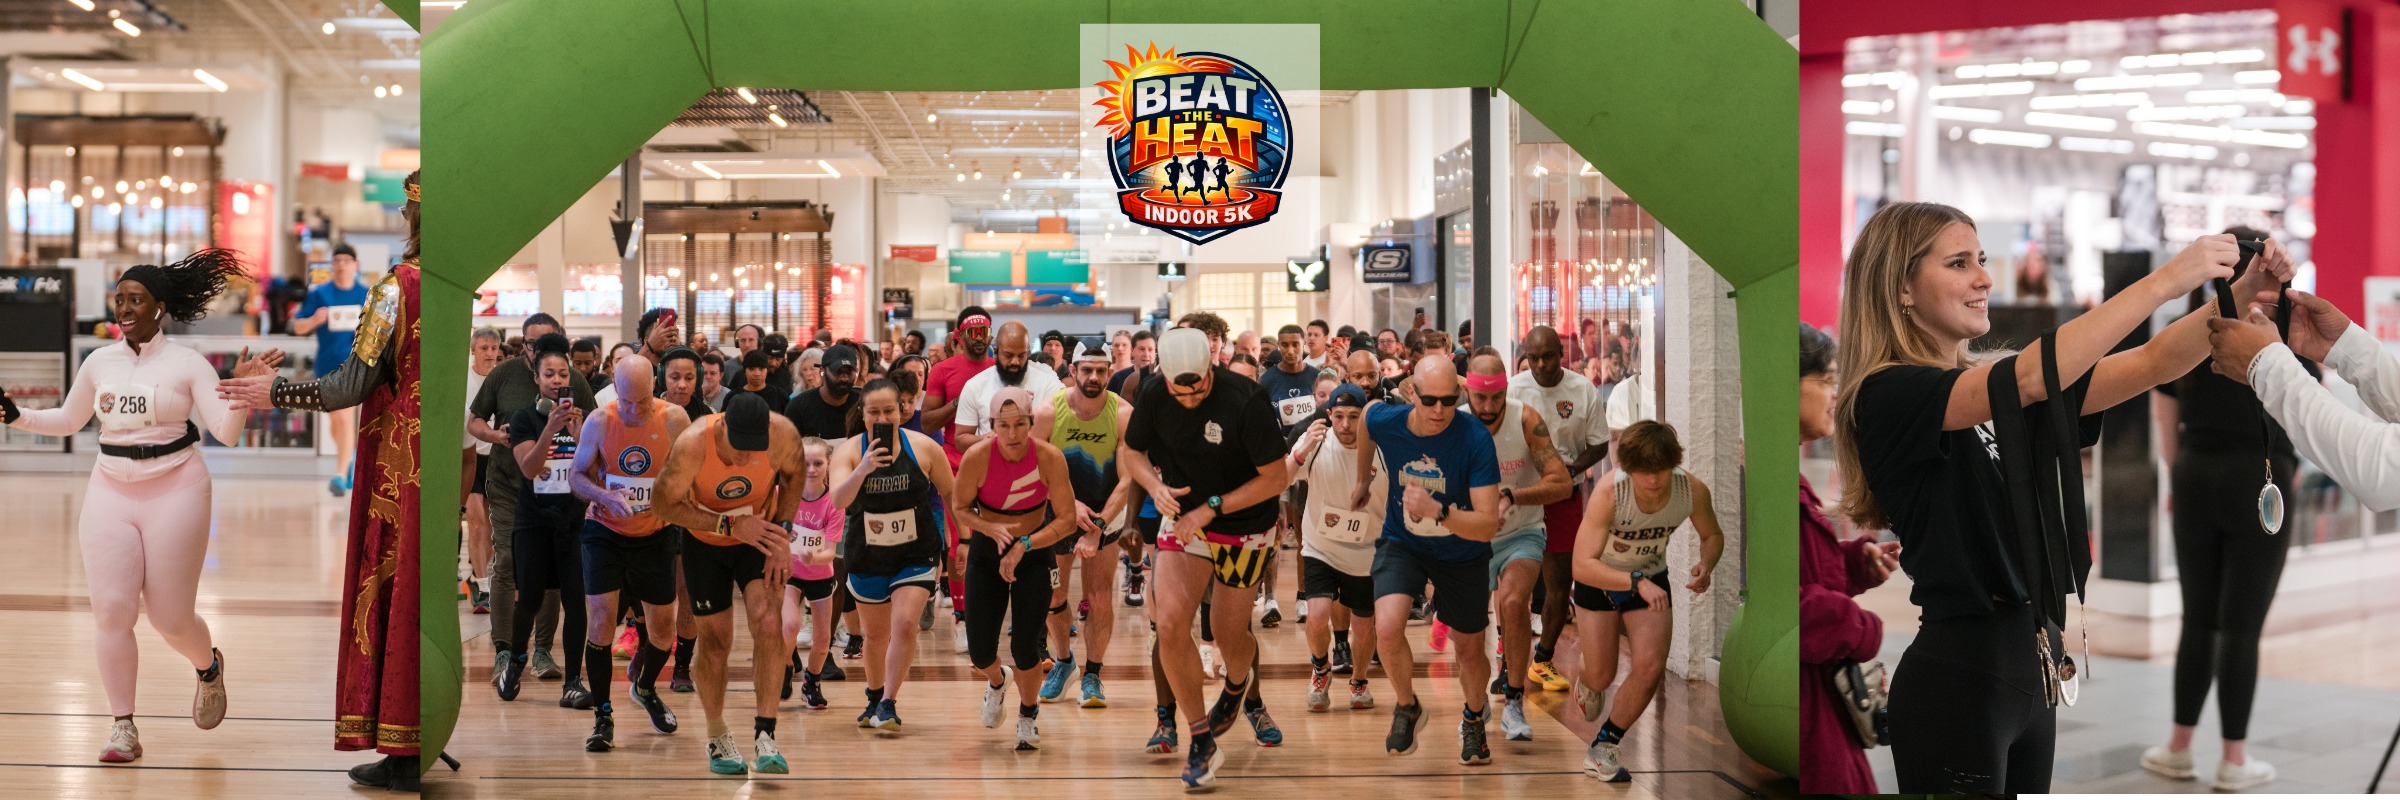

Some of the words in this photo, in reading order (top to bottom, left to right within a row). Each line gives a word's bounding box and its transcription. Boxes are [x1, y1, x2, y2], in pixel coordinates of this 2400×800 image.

[120, 396, 147, 414] 258
[1296, 402, 1313, 414] 205
[799, 510, 822, 528] ISLA
[1347, 518, 1361, 532] 10
[891, 519, 906, 534] 97
[802, 535, 822, 547] 158
[1635, 545, 1659, 556] 194
